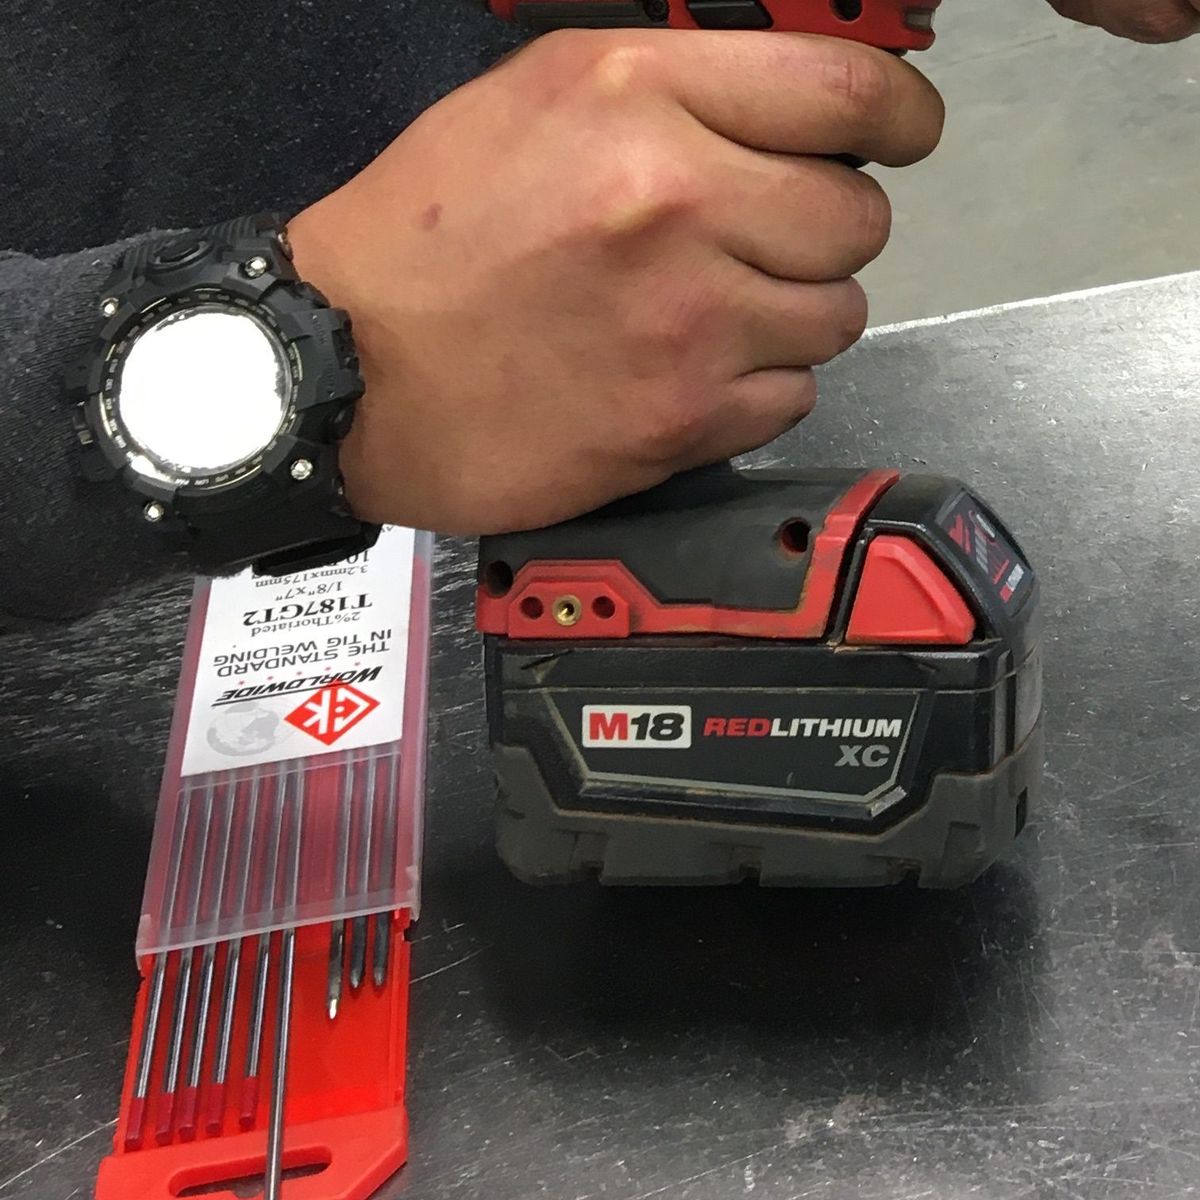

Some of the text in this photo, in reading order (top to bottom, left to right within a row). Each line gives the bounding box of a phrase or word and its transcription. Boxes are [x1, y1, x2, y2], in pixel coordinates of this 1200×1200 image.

[242, 592, 373, 626] T187GT2
[213, 628, 392, 667] IN TIG WELDING
[217, 640, 390, 678] THE STANDARD
[214, 665, 383, 703] WORLDWIDE
[587, 711, 902, 741] M18 REDLITHIUM
[834, 743, 890, 768] XC
